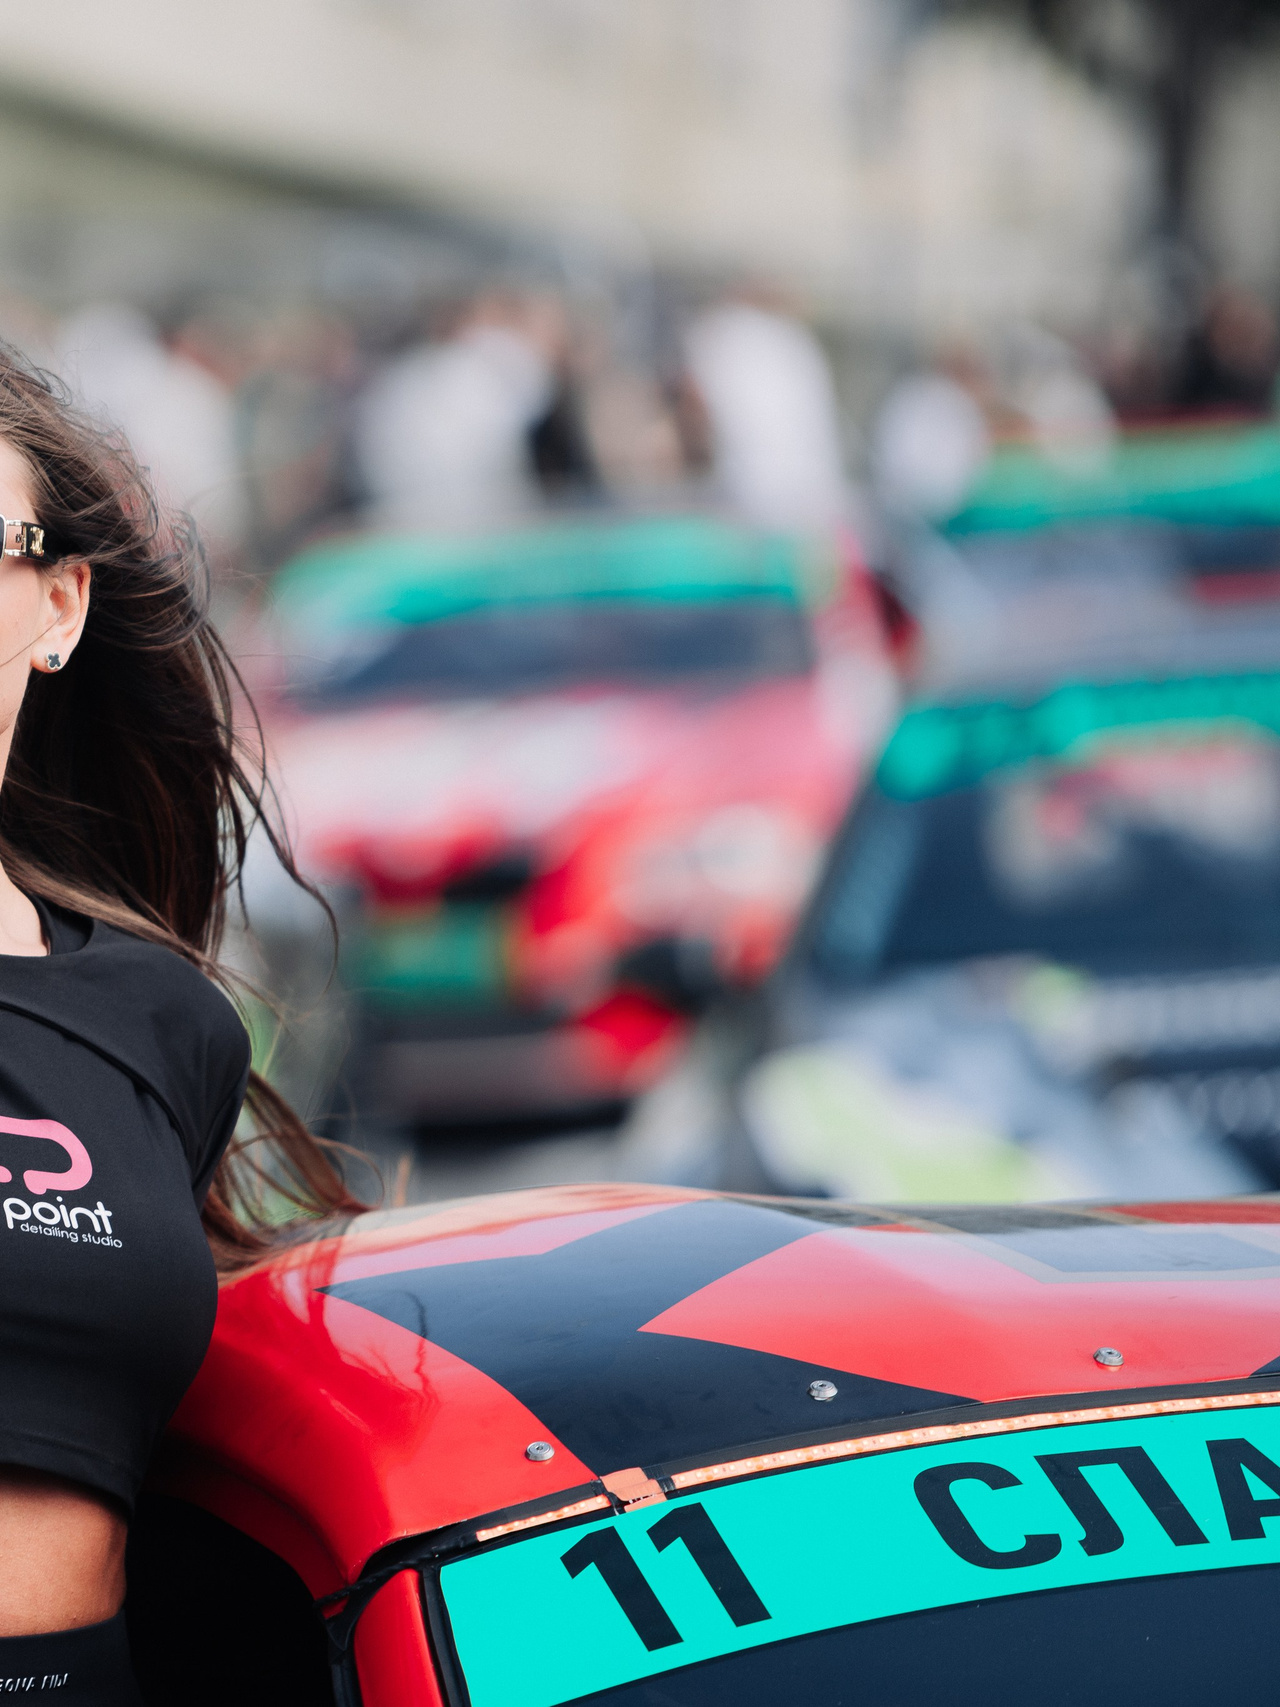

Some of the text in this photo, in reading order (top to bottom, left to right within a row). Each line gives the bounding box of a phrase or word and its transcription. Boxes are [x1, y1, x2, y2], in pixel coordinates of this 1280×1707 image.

[20, 1222, 123, 1249] detailing studio
[560, 1437, 1280, 1653] 11 СЛА
